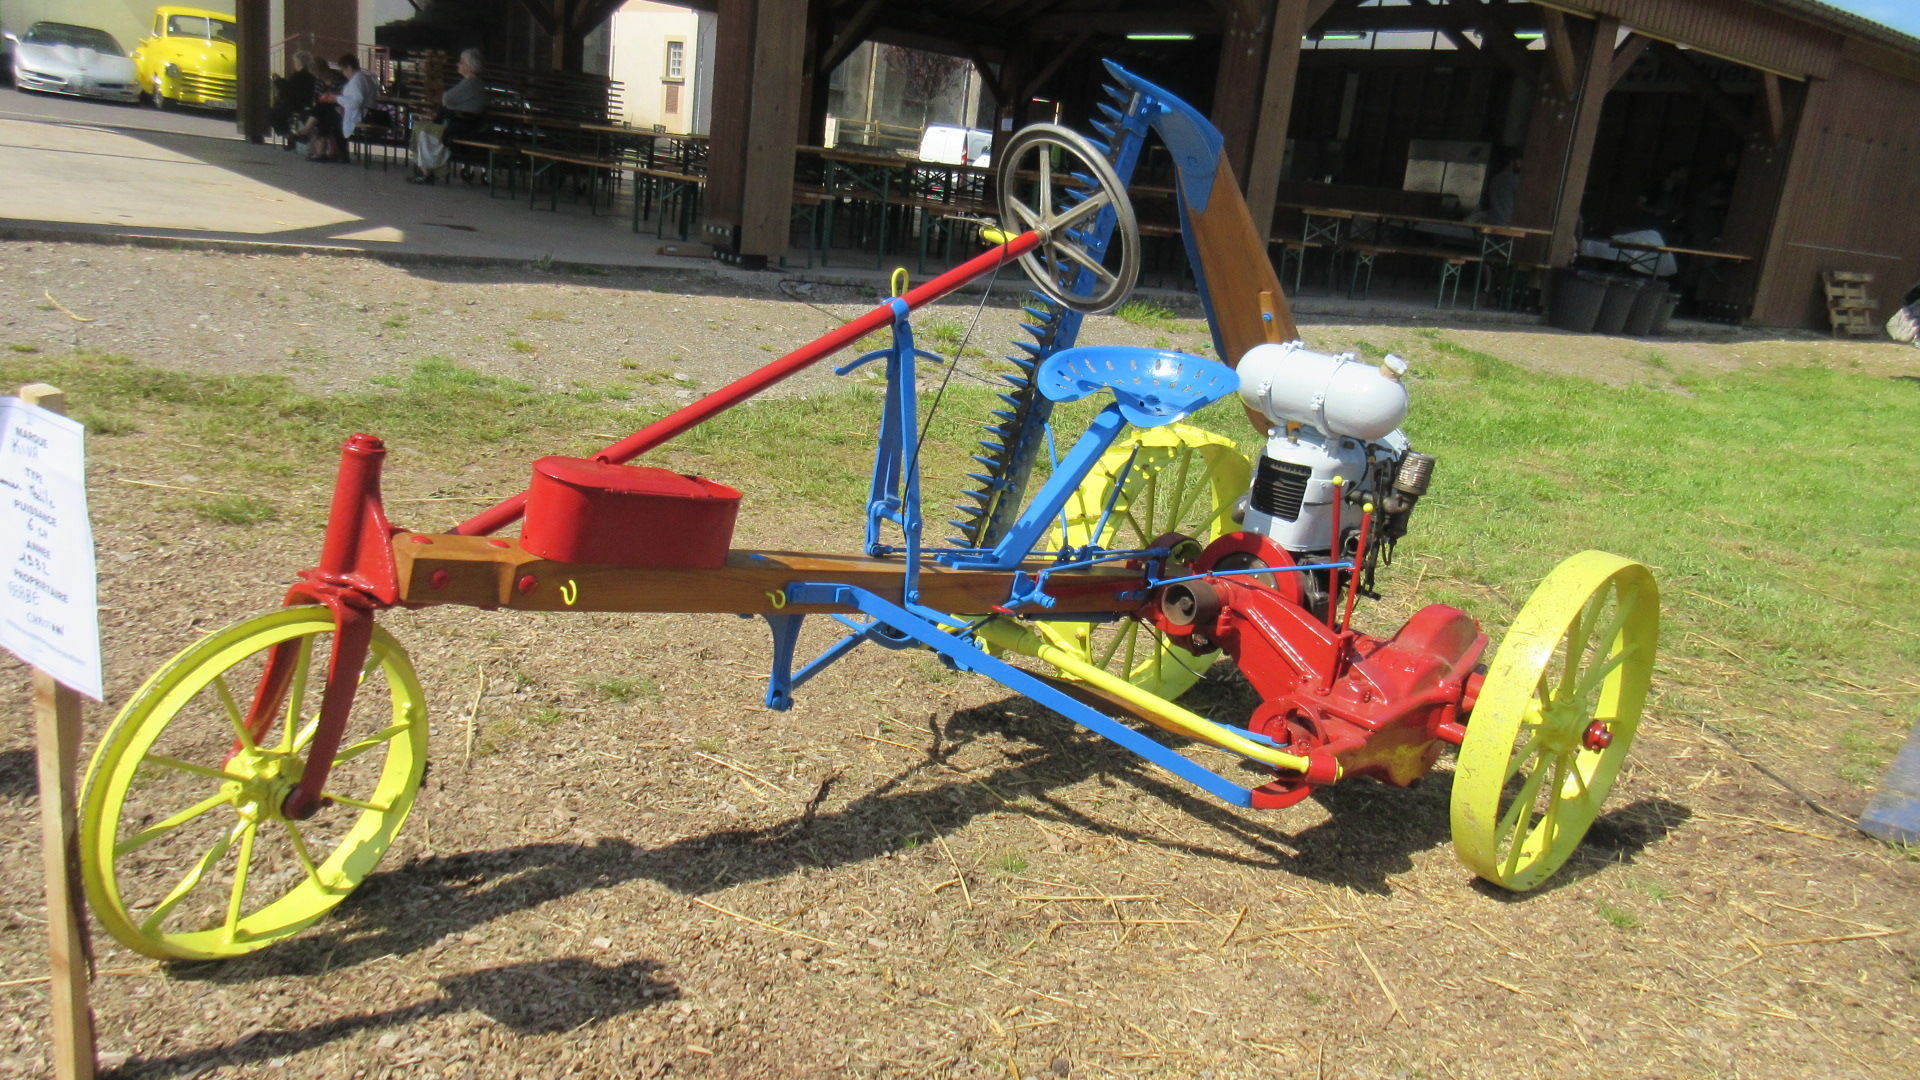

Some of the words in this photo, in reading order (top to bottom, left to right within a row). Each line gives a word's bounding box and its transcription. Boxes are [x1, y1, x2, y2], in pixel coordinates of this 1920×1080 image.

[15, 426, 48, 448] MARQUE
[25, 467, 44, 484] TYPE
[14, 499, 57, 528] PUISSANCE
